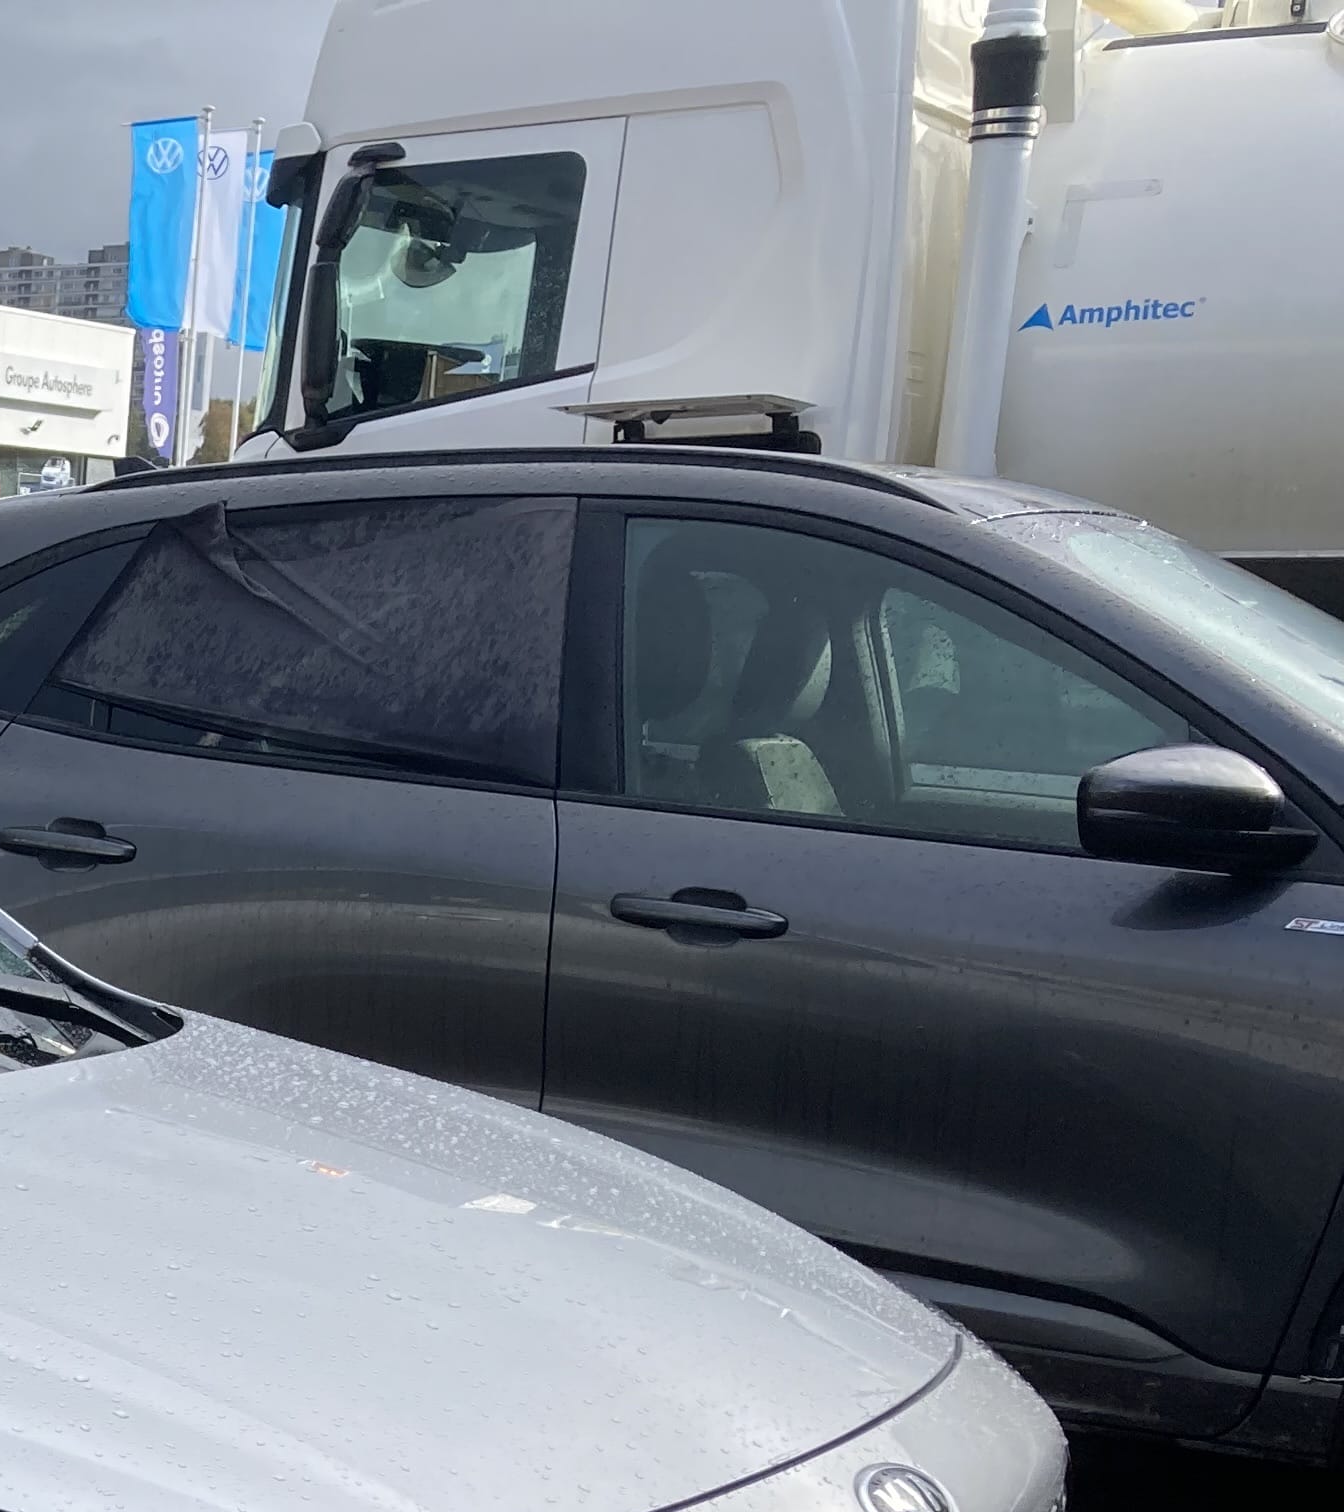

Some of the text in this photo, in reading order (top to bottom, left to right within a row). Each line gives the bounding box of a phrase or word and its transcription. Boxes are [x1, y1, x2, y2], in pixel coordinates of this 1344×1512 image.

[1058, 298, 1195, 327] Amphitec
[5, 366, 93, 398] Groupe Autosphere
